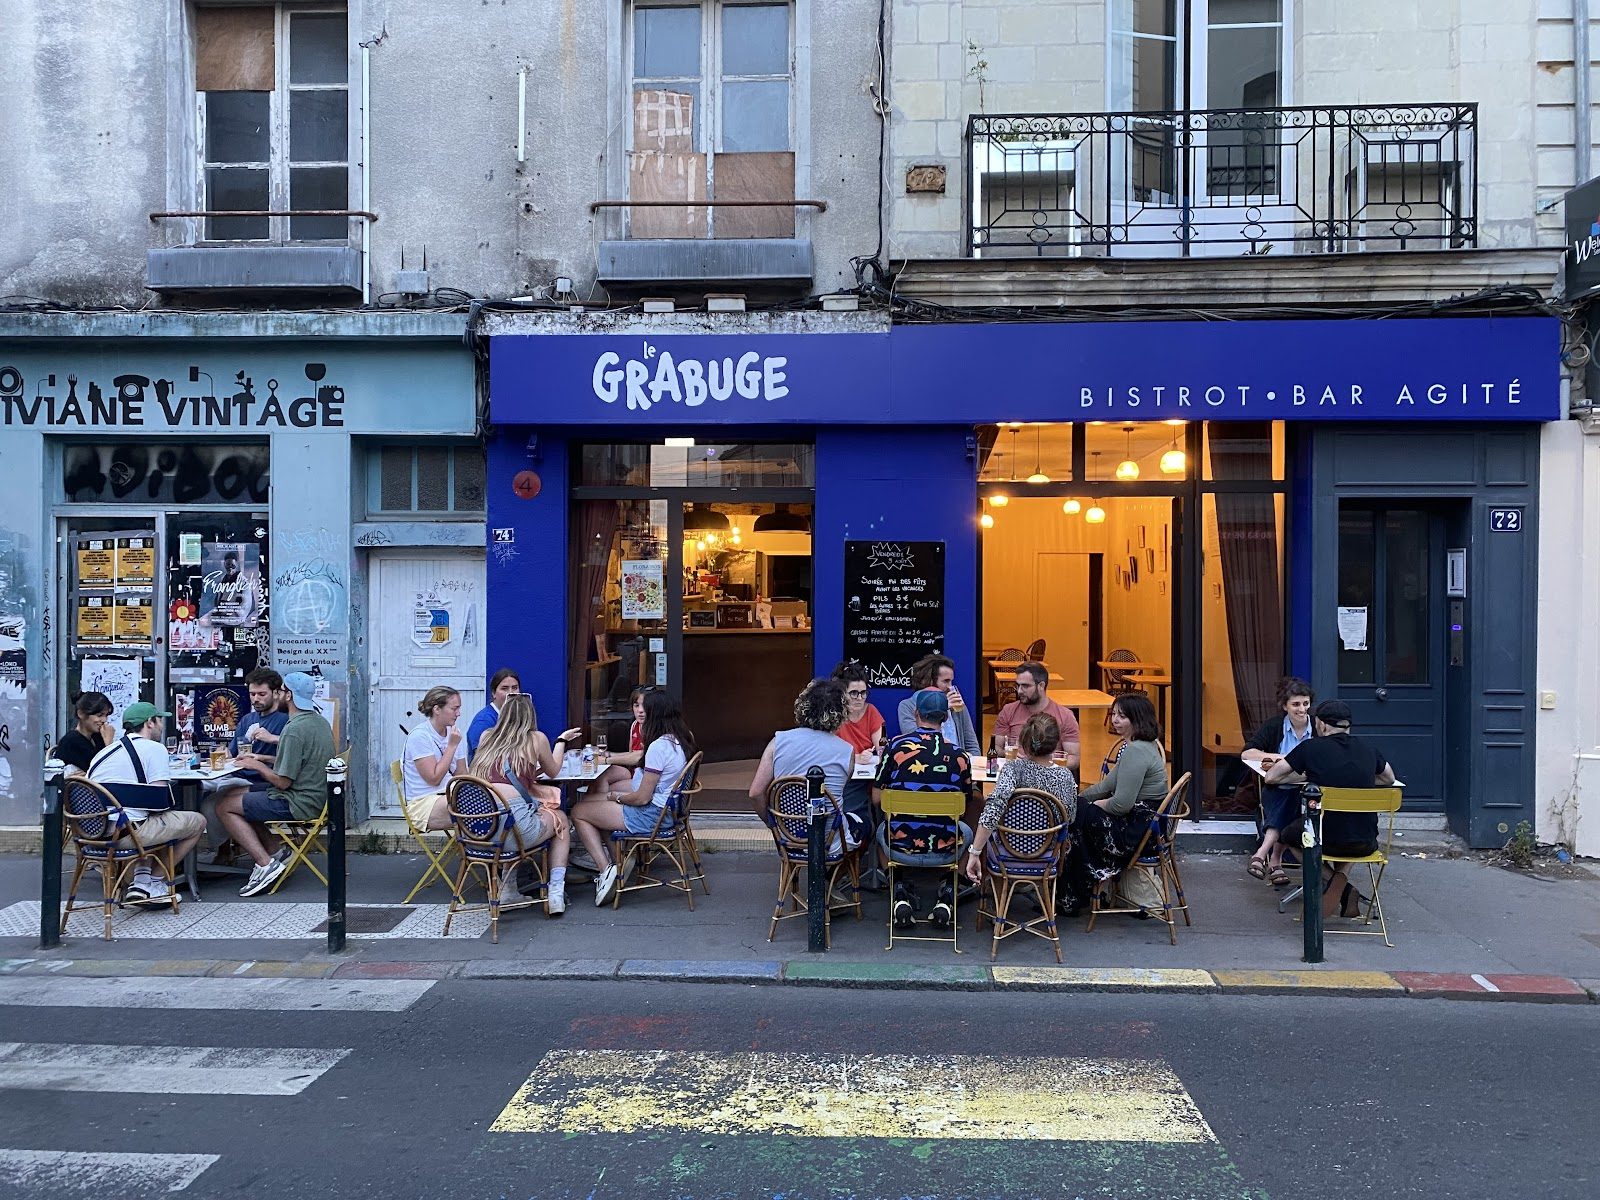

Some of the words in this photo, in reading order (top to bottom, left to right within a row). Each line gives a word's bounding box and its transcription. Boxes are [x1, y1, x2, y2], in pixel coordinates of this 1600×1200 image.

[643, 341, 657, 359] le
[593, 351, 789, 411] GRABUGE
[1080, 385, 1251, 408] BISTROT
[1293, 384, 1364, 406] BAR
[1396, 378, 1522, 405] AGITÉ
[0, 391, 144, 426] IVIANE
[157, 391, 344, 427] VINTAGE
[1495, 511, 1517, 529] 72
[495, 530, 510, 541] 74
[277, 648, 302, 656] Design
[278, 658, 307, 666] Friperie
[310, 658, 340, 666] Vintage
[874, 675, 911, 686] GRABUGE
[204, 723, 229, 732] DUMB
